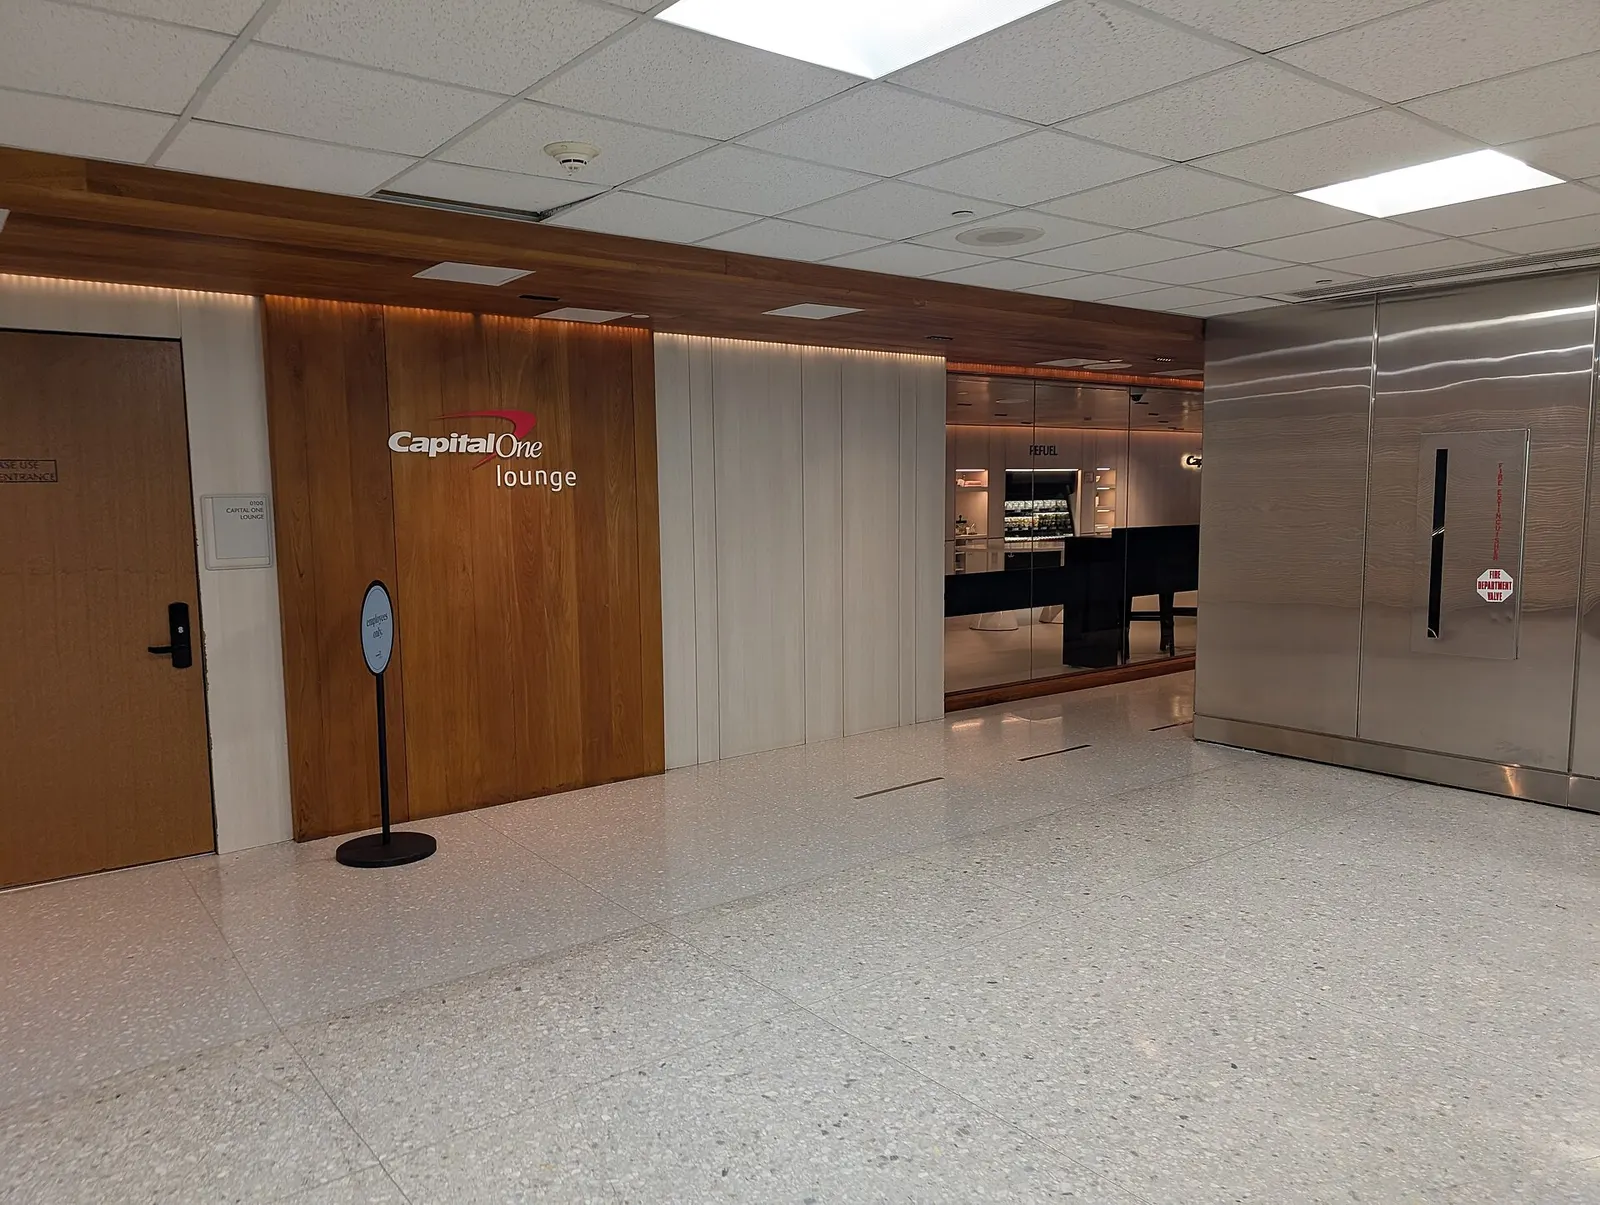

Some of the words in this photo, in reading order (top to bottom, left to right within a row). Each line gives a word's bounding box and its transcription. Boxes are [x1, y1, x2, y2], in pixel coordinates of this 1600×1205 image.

[20, 461, 40, 470] USE
[496, 464, 577, 492] lounge
[1489, 570, 1501, 579] FIRE
[1478, 581, 1512, 590] DEPARTMENT
[1487, 592, 1503, 601] VALVE
